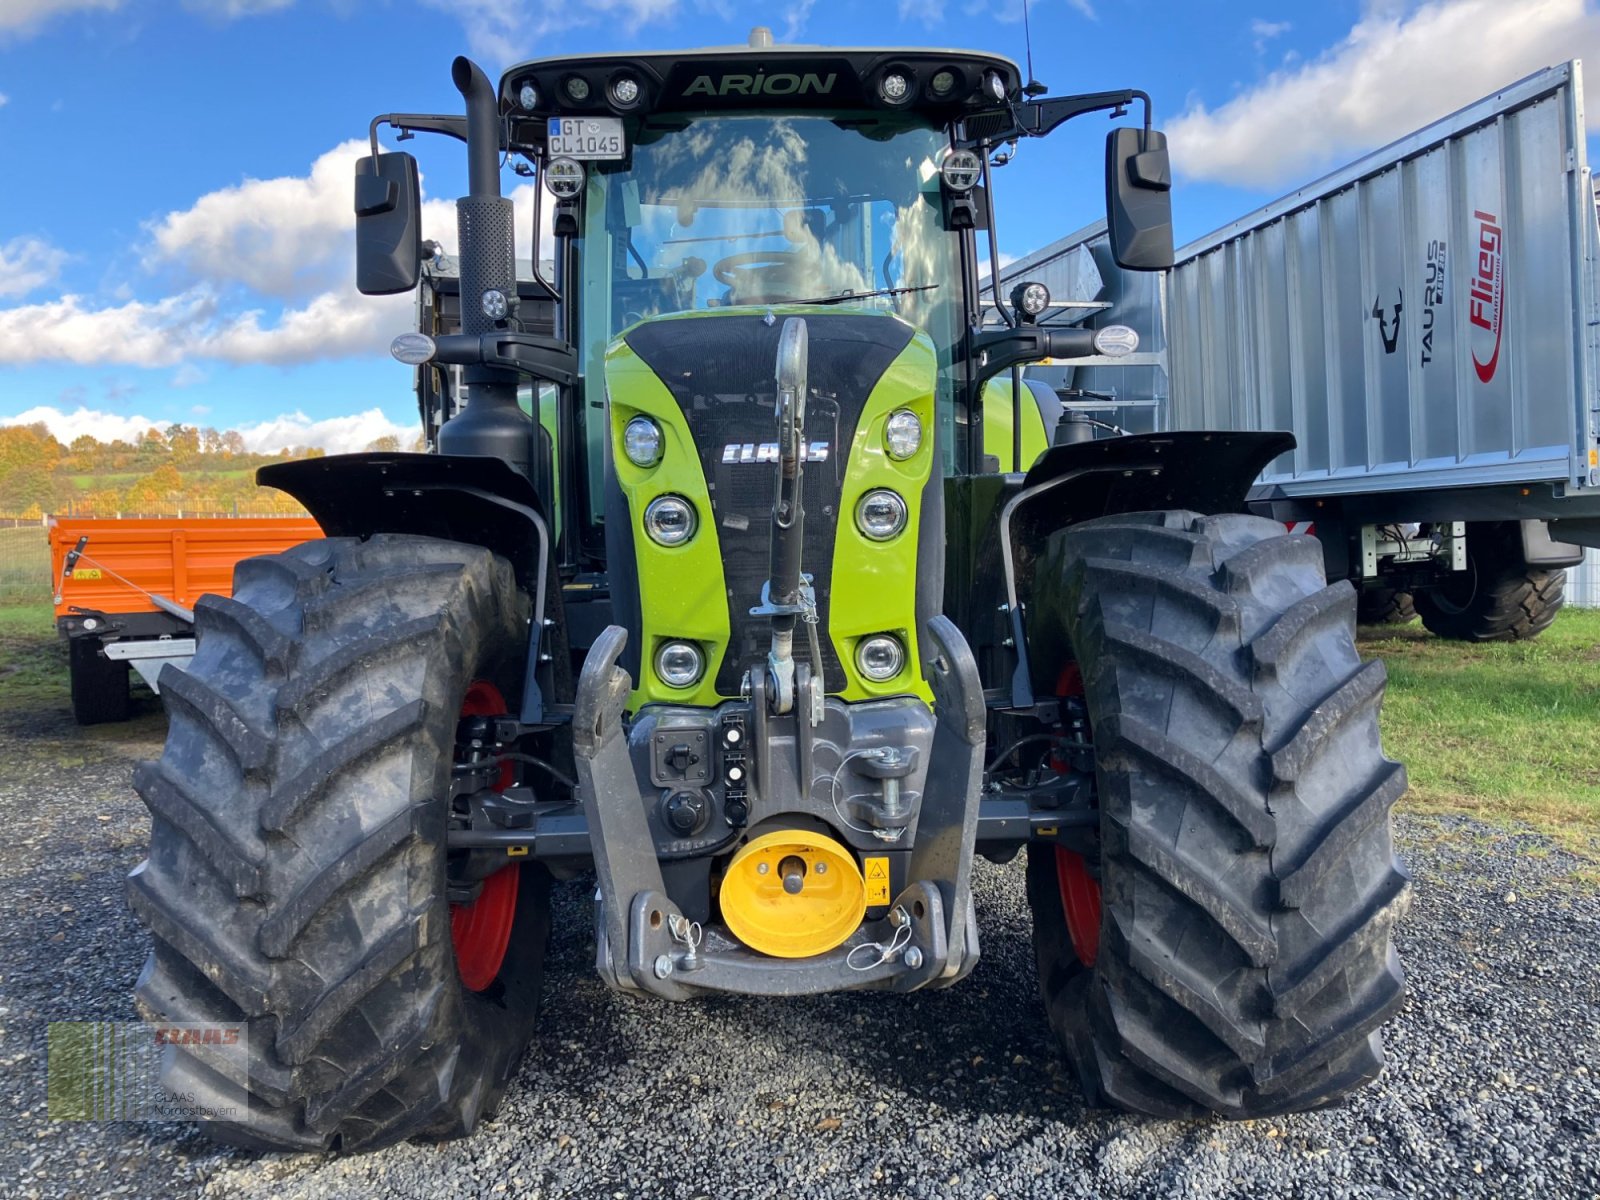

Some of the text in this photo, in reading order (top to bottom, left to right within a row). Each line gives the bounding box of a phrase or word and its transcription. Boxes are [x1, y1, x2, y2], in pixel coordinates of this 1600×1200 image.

[681, 73, 837, 96] ARION
[563, 120, 585, 136] GT
[1421, 239, 1439, 368] TAURUS
[1470, 209, 1502, 331] Fliegl
[1492, 257, 1501, 335] AGRARTECHNIK
